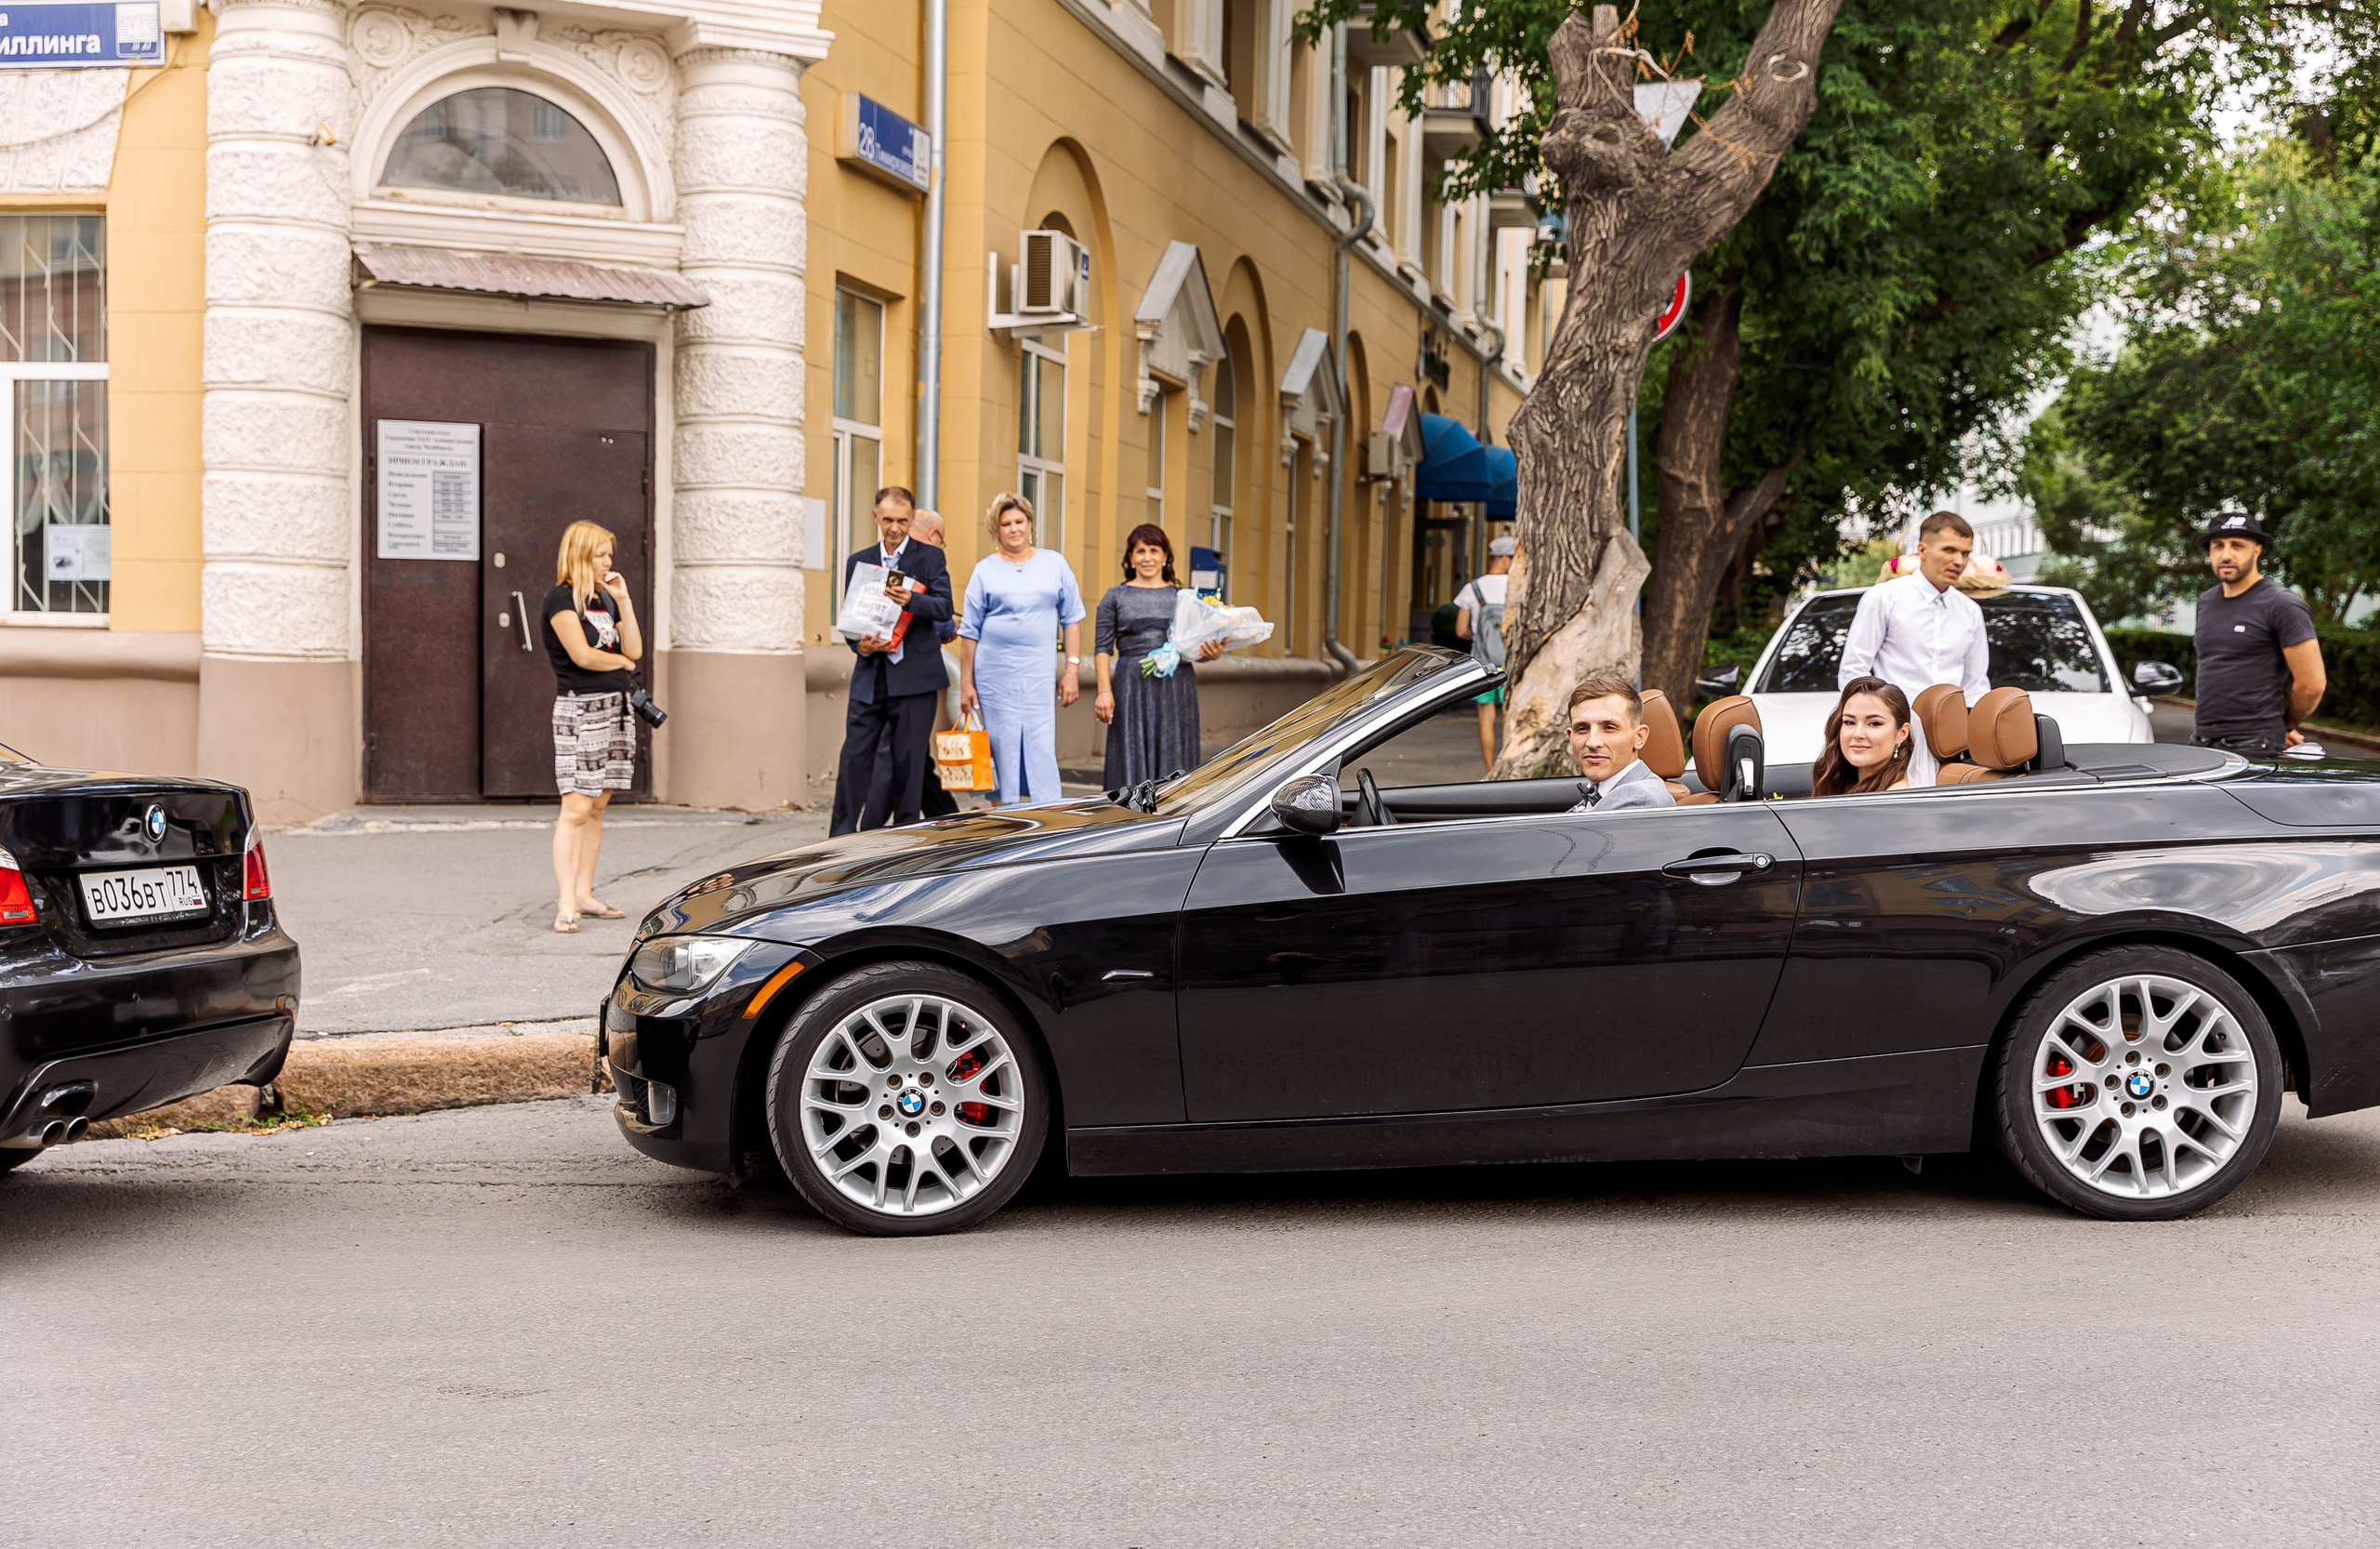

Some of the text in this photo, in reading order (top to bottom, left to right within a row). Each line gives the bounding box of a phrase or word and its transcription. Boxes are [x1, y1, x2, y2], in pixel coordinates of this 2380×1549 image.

[858, 121, 875, 160] 28
[91, 869, 197, 914] В036ВТ 774
[178, 896, 193, 907] RUS
